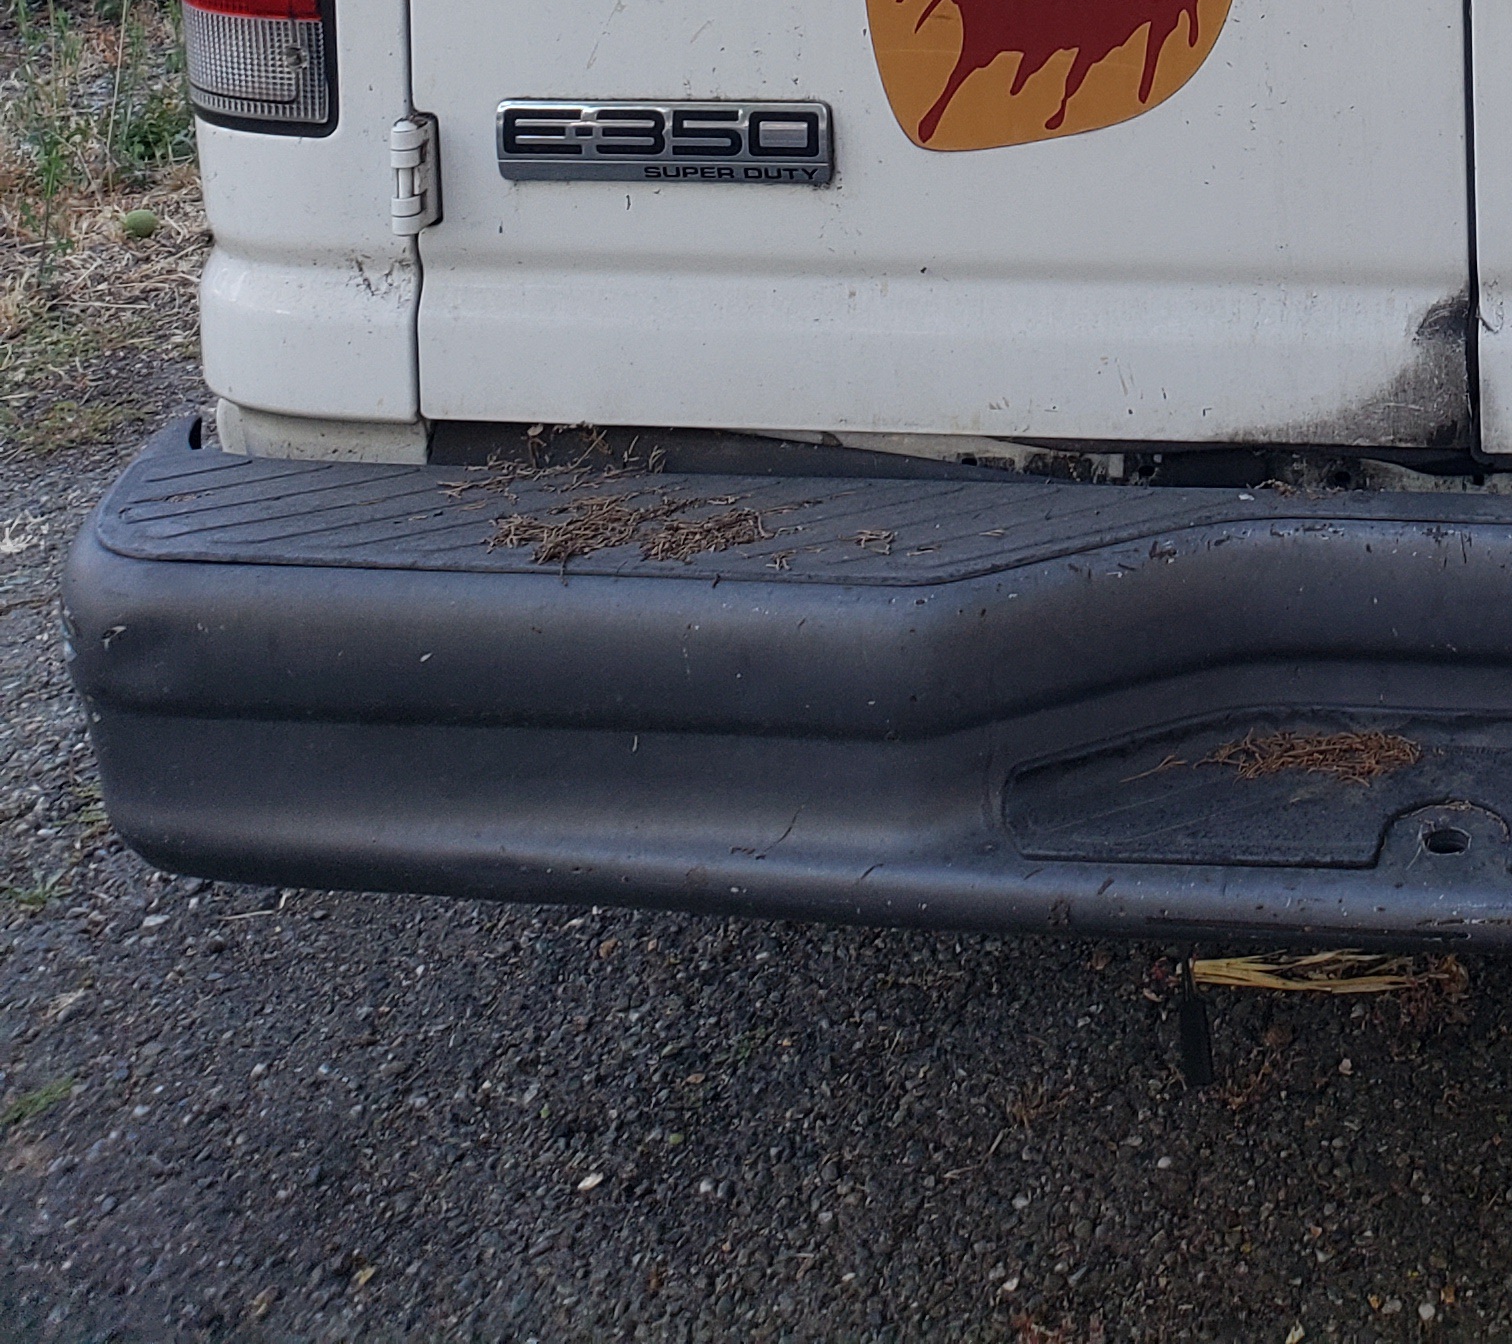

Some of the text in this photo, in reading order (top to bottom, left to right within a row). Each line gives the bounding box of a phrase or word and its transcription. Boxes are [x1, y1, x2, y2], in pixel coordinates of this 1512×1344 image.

[502, 107, 820, 158] E-350
[644, 166, 819, 181] SUPER DUTY
